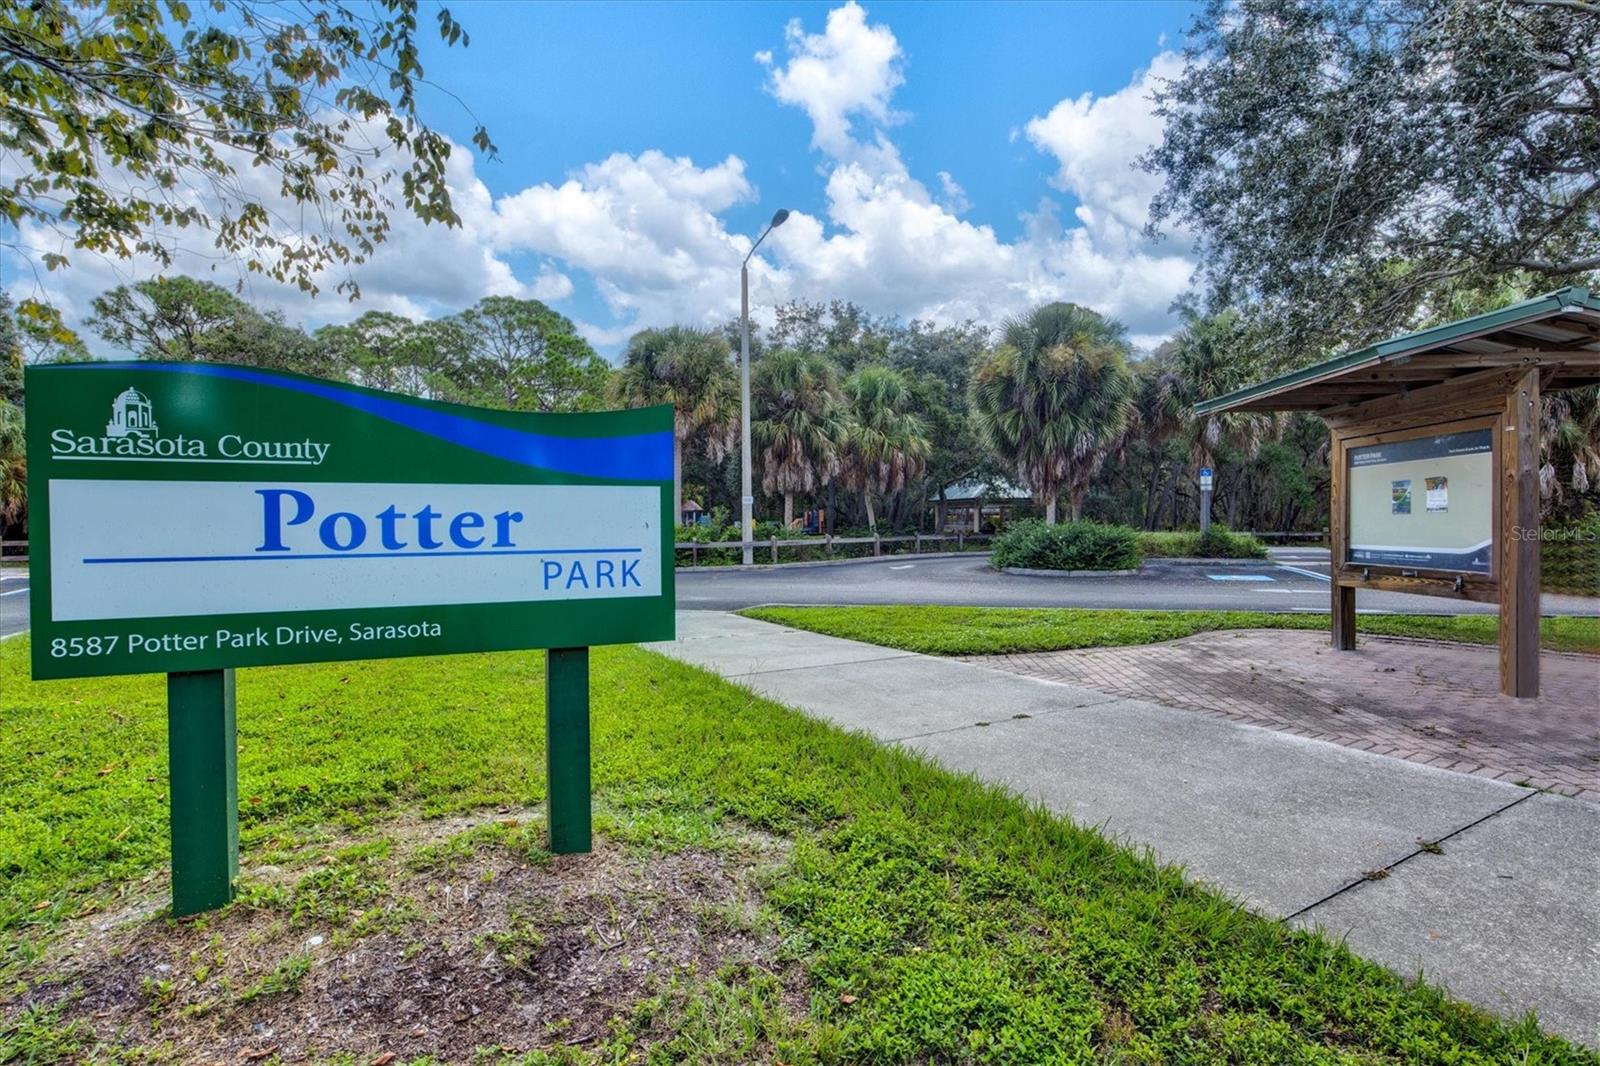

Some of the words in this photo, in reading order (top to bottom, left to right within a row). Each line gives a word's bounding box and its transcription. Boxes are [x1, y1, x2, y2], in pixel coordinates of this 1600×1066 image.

[51, 429, 206, 456] Sarasota
[218, 434, 331, 465] County
[255, 489, 524, 552] Potter
[543, 559, 642, 590] PARK
[50, 636, 119, 657] 8587
[127, 632, 208, 654] Potter
[216, 627, 270, 649] Park
[277, 623, 344, 646] Drive,
[350, 620, 442, 641] Sarasota
